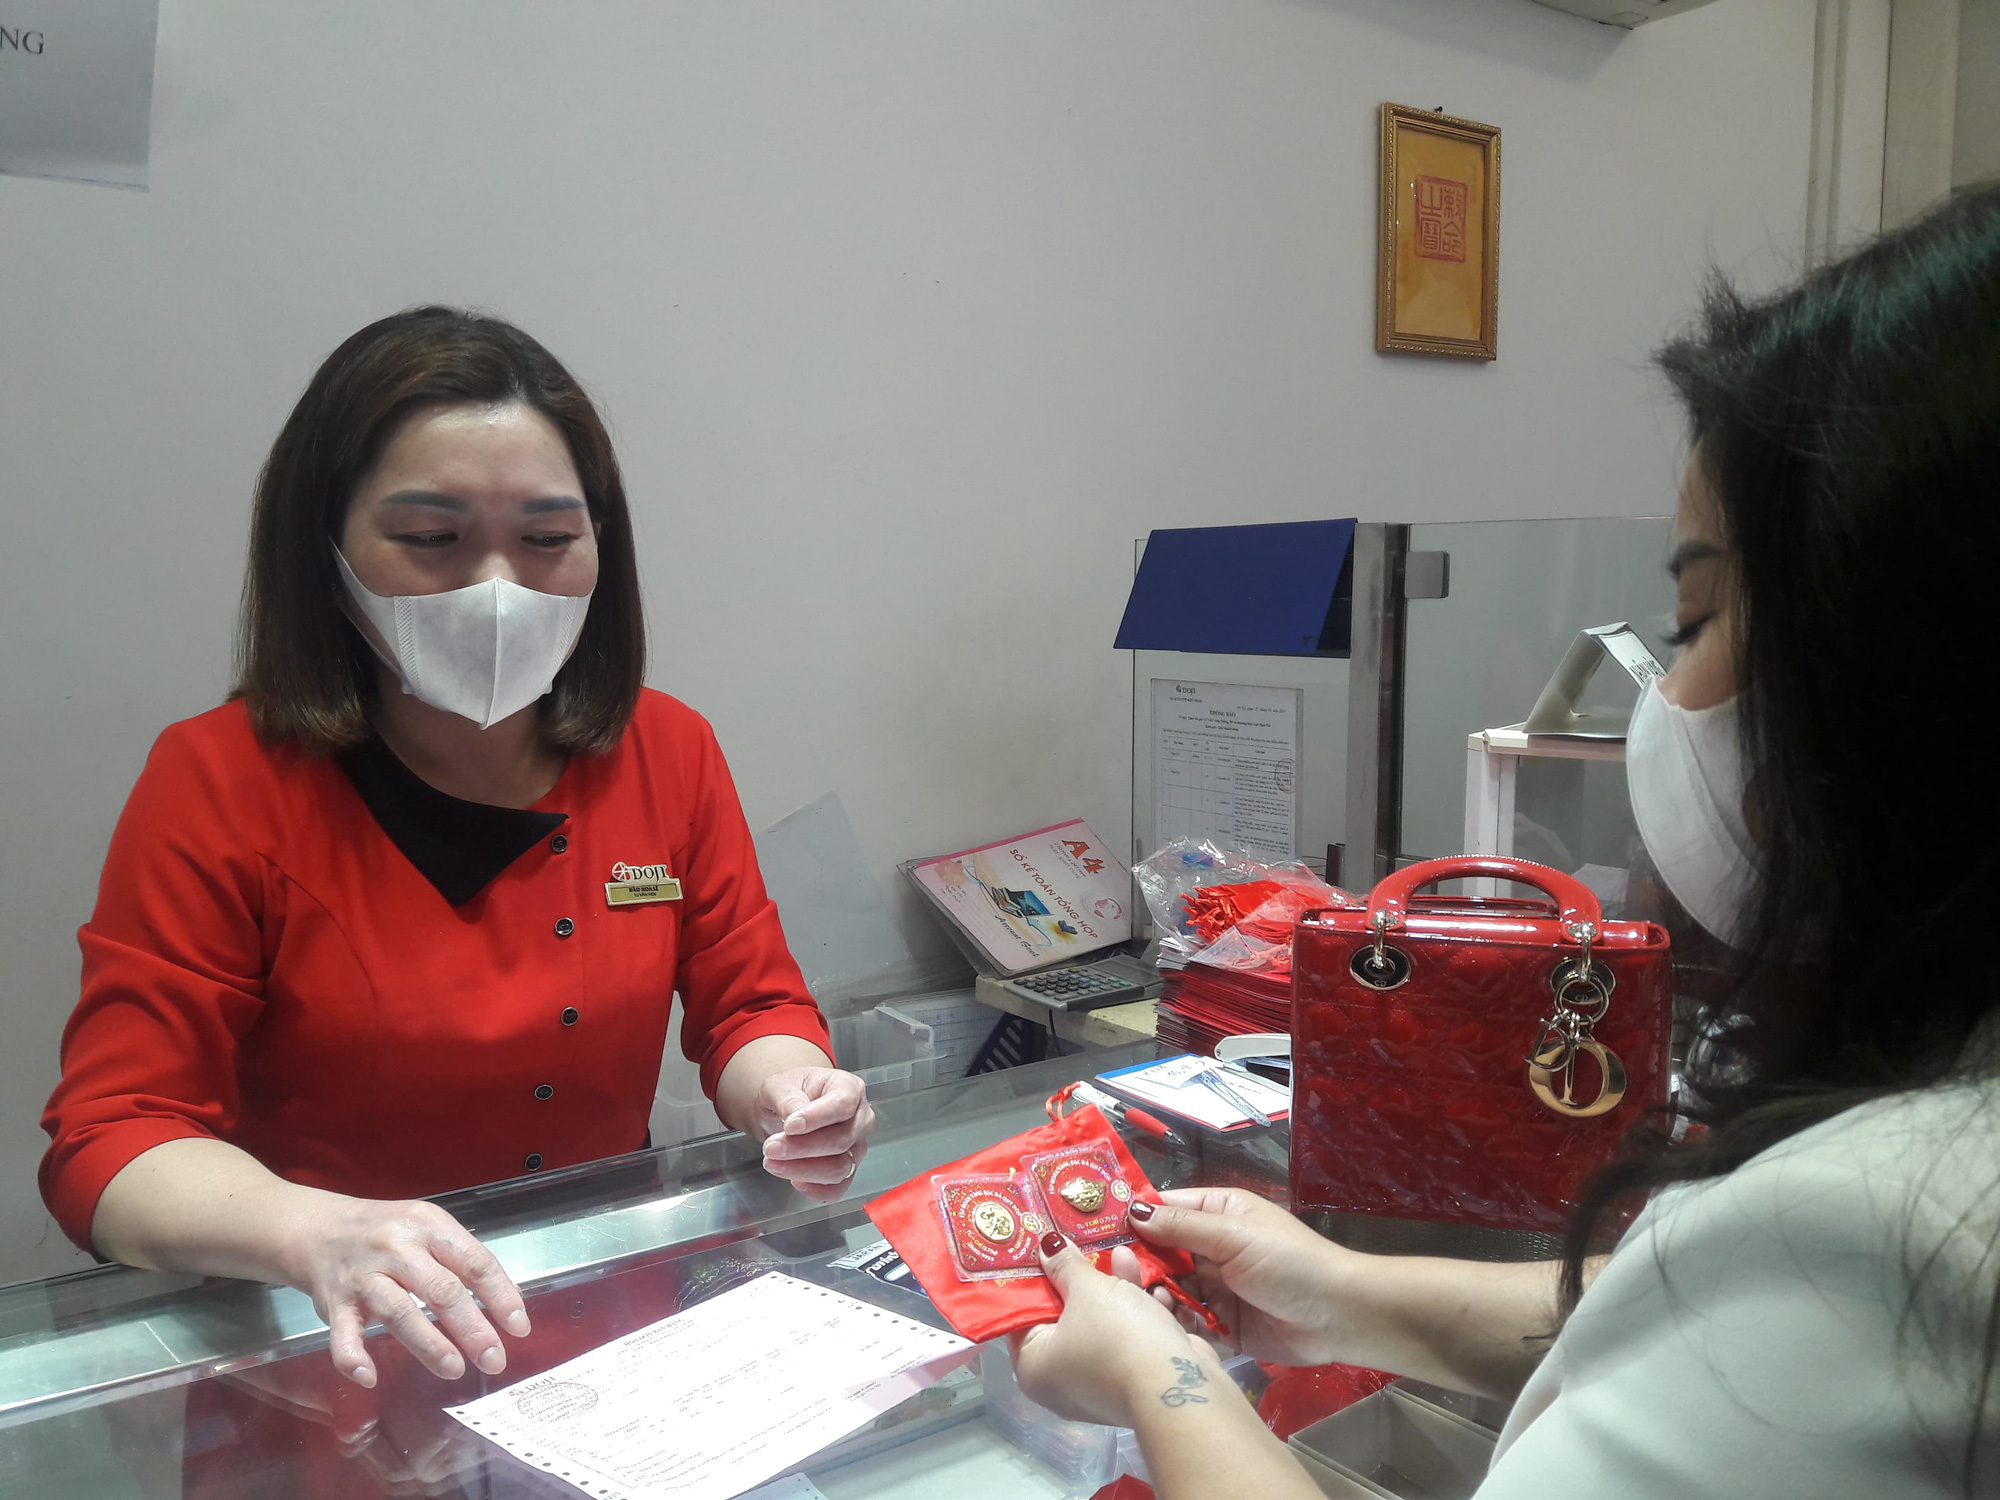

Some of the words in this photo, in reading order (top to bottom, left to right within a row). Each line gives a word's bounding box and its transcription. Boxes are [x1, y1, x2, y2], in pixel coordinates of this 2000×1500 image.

[632, 865, 668, 882] DOJI
[1062, 840, 1105, 875] A4
[1010, 849, 1028, 862] SỔ
[1021, 862, 1038, 873] KẾ
[1032, 873, 1057, 896] TOÁN
[1054, 896, 1080, 920] TỔNG
[1077, 920, 1099, 939] HỢP
